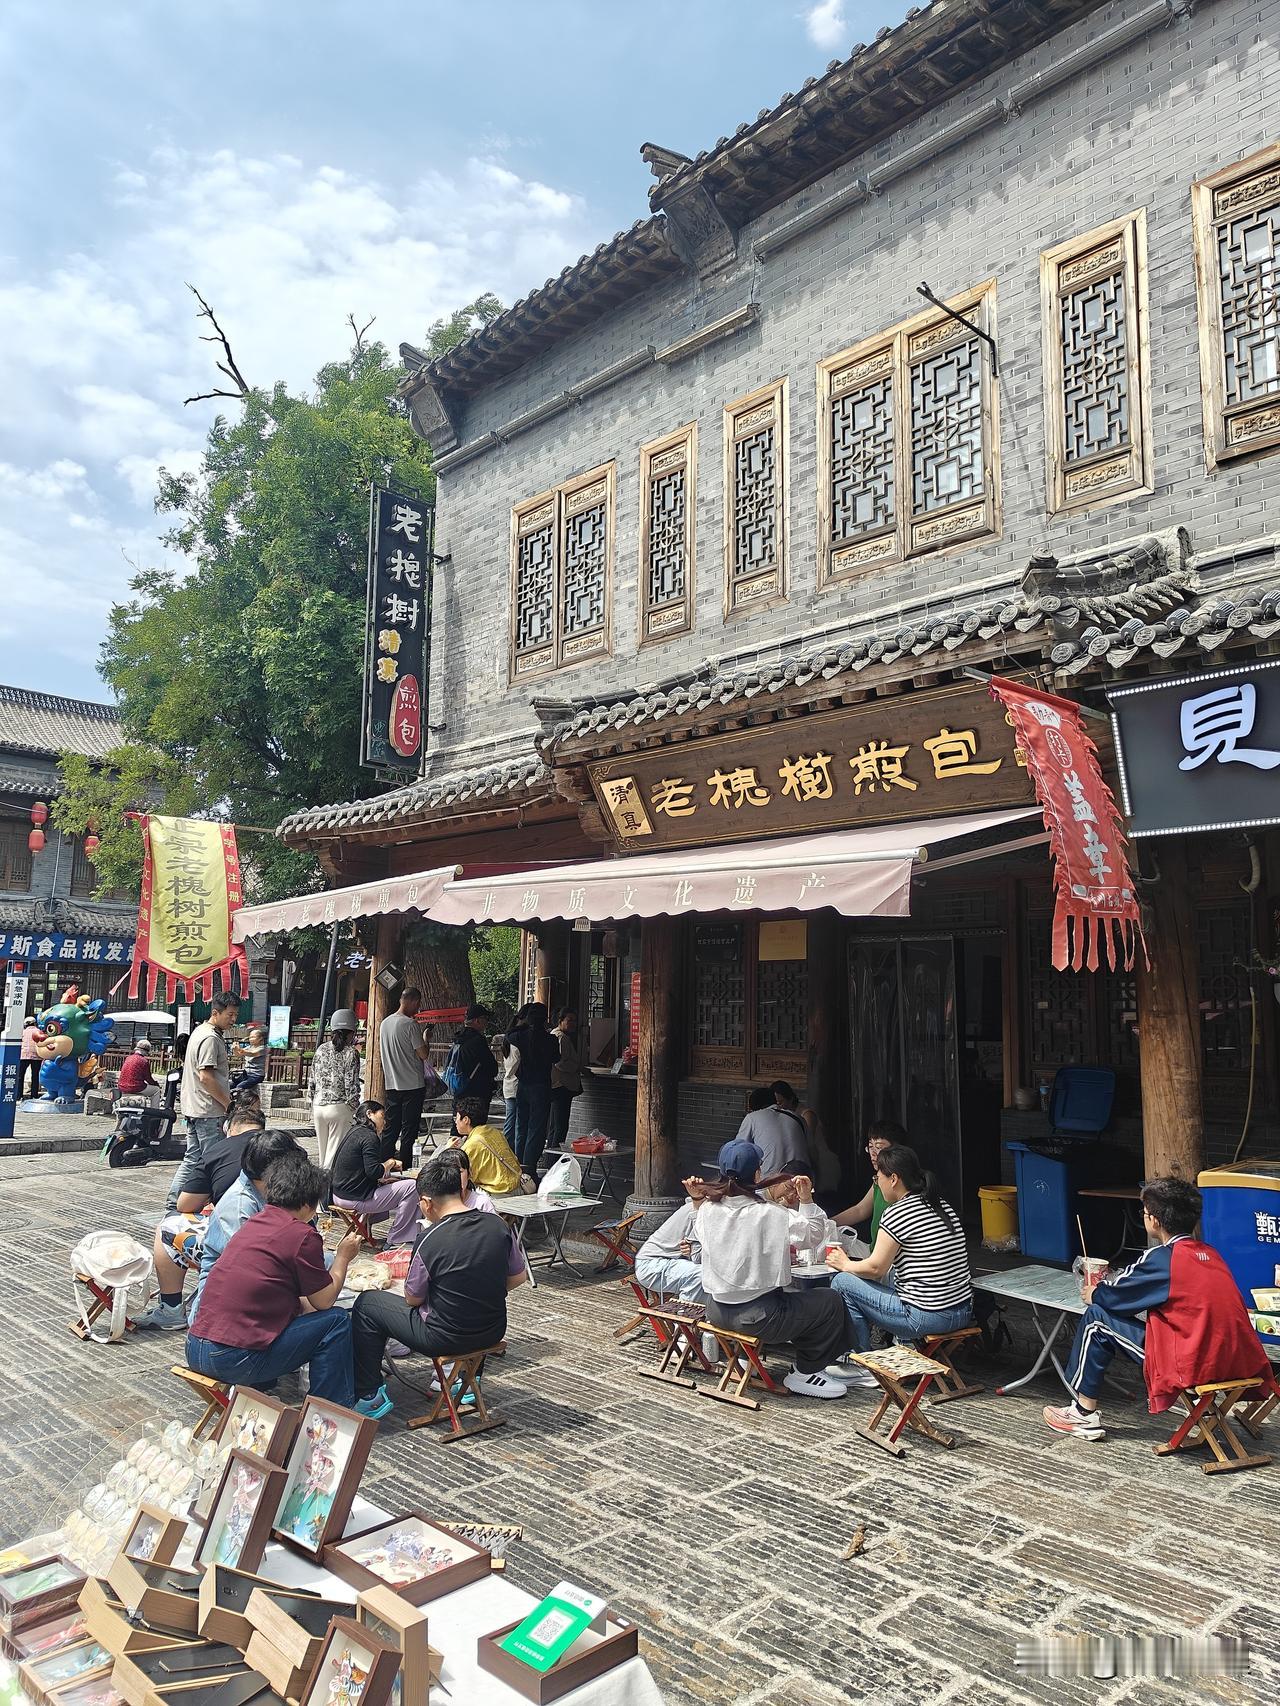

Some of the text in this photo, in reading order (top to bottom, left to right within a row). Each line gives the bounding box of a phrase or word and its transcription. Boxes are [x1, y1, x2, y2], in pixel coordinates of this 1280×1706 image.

[388, 505, 423, 630] 老槐樹
[378, 629, 402, 682] 清真
[398, 686, 418, 745] 煎包
[1178, 683, 1280, 770] 見
[650, 727, 1003, 818] 老槐樹煎包
[610, 783, 642, 831] 清真
[165, 818, 213, 965] 正宗老槐树煎包
[222, 824, 241, 940] 老字号注册
[254, 884, 419, 930] 正宗老槐树煎包
[481, 872, 827, 915] 非物质文化遗产
[12, 979, 24, 1006] 紧急求助
[3, 1064, 17, 1102] 报警点
[1254, 1211, 1280, 1237] 甄
